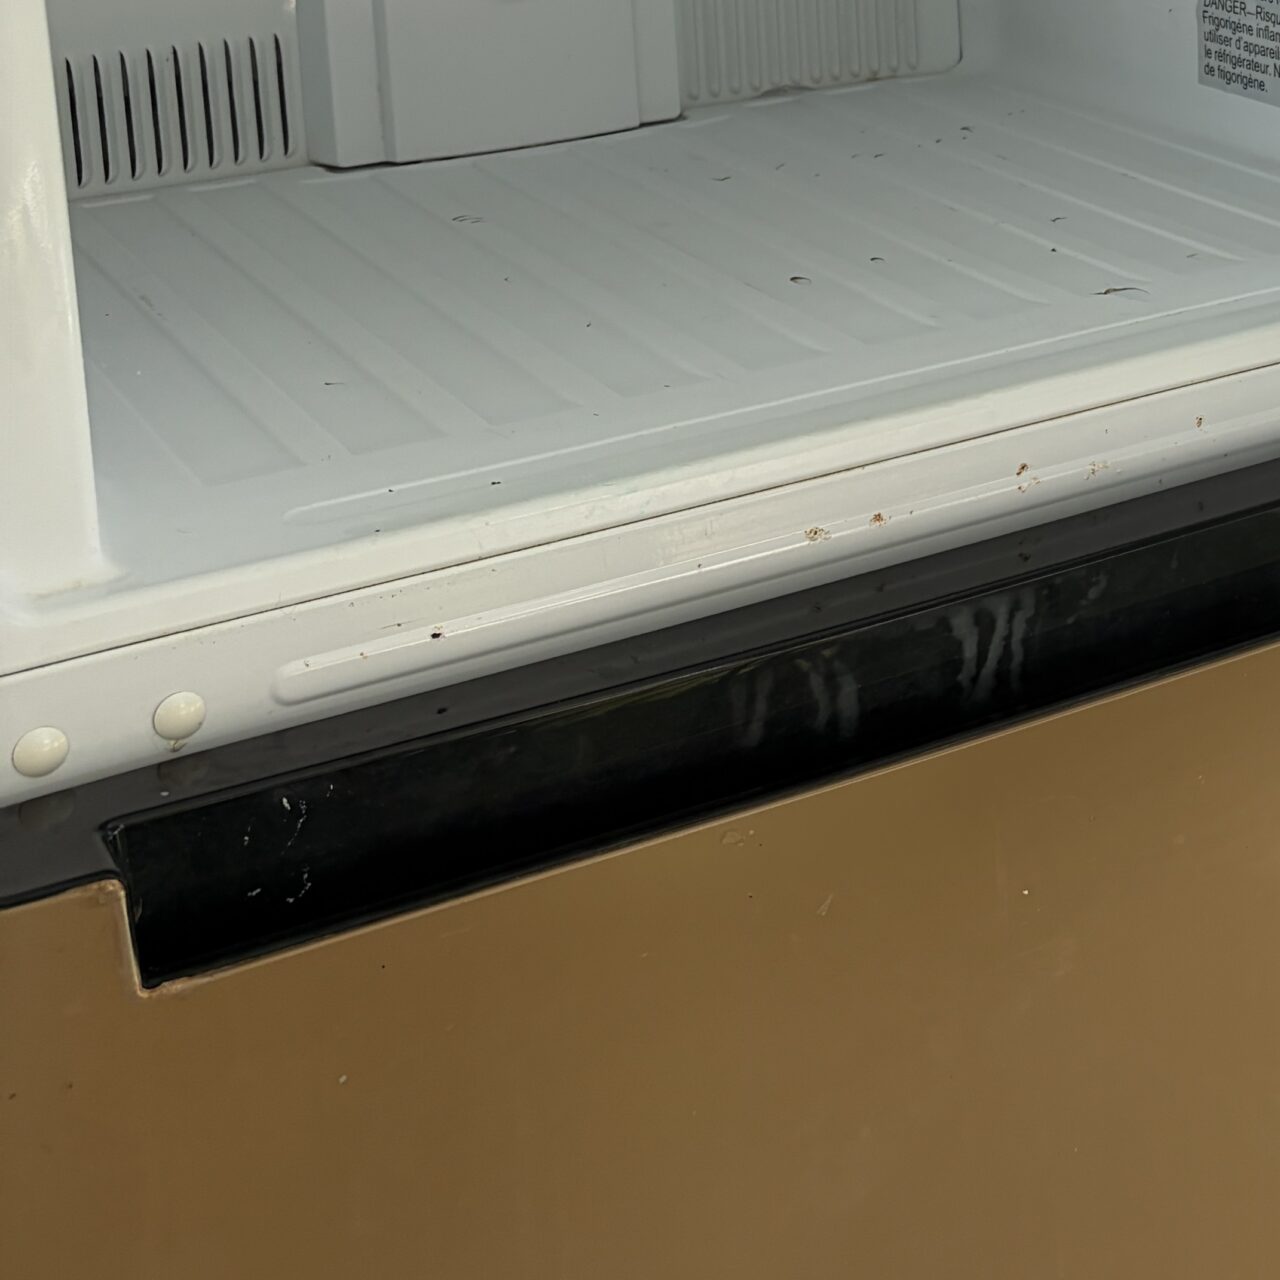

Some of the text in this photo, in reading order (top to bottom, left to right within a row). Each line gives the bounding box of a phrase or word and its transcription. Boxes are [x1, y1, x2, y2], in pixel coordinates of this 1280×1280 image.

[1203, 30, 1233, 49] utiliser
[1203, 43, 1213, 60] le
[1203, 61, 1216, 78] de
